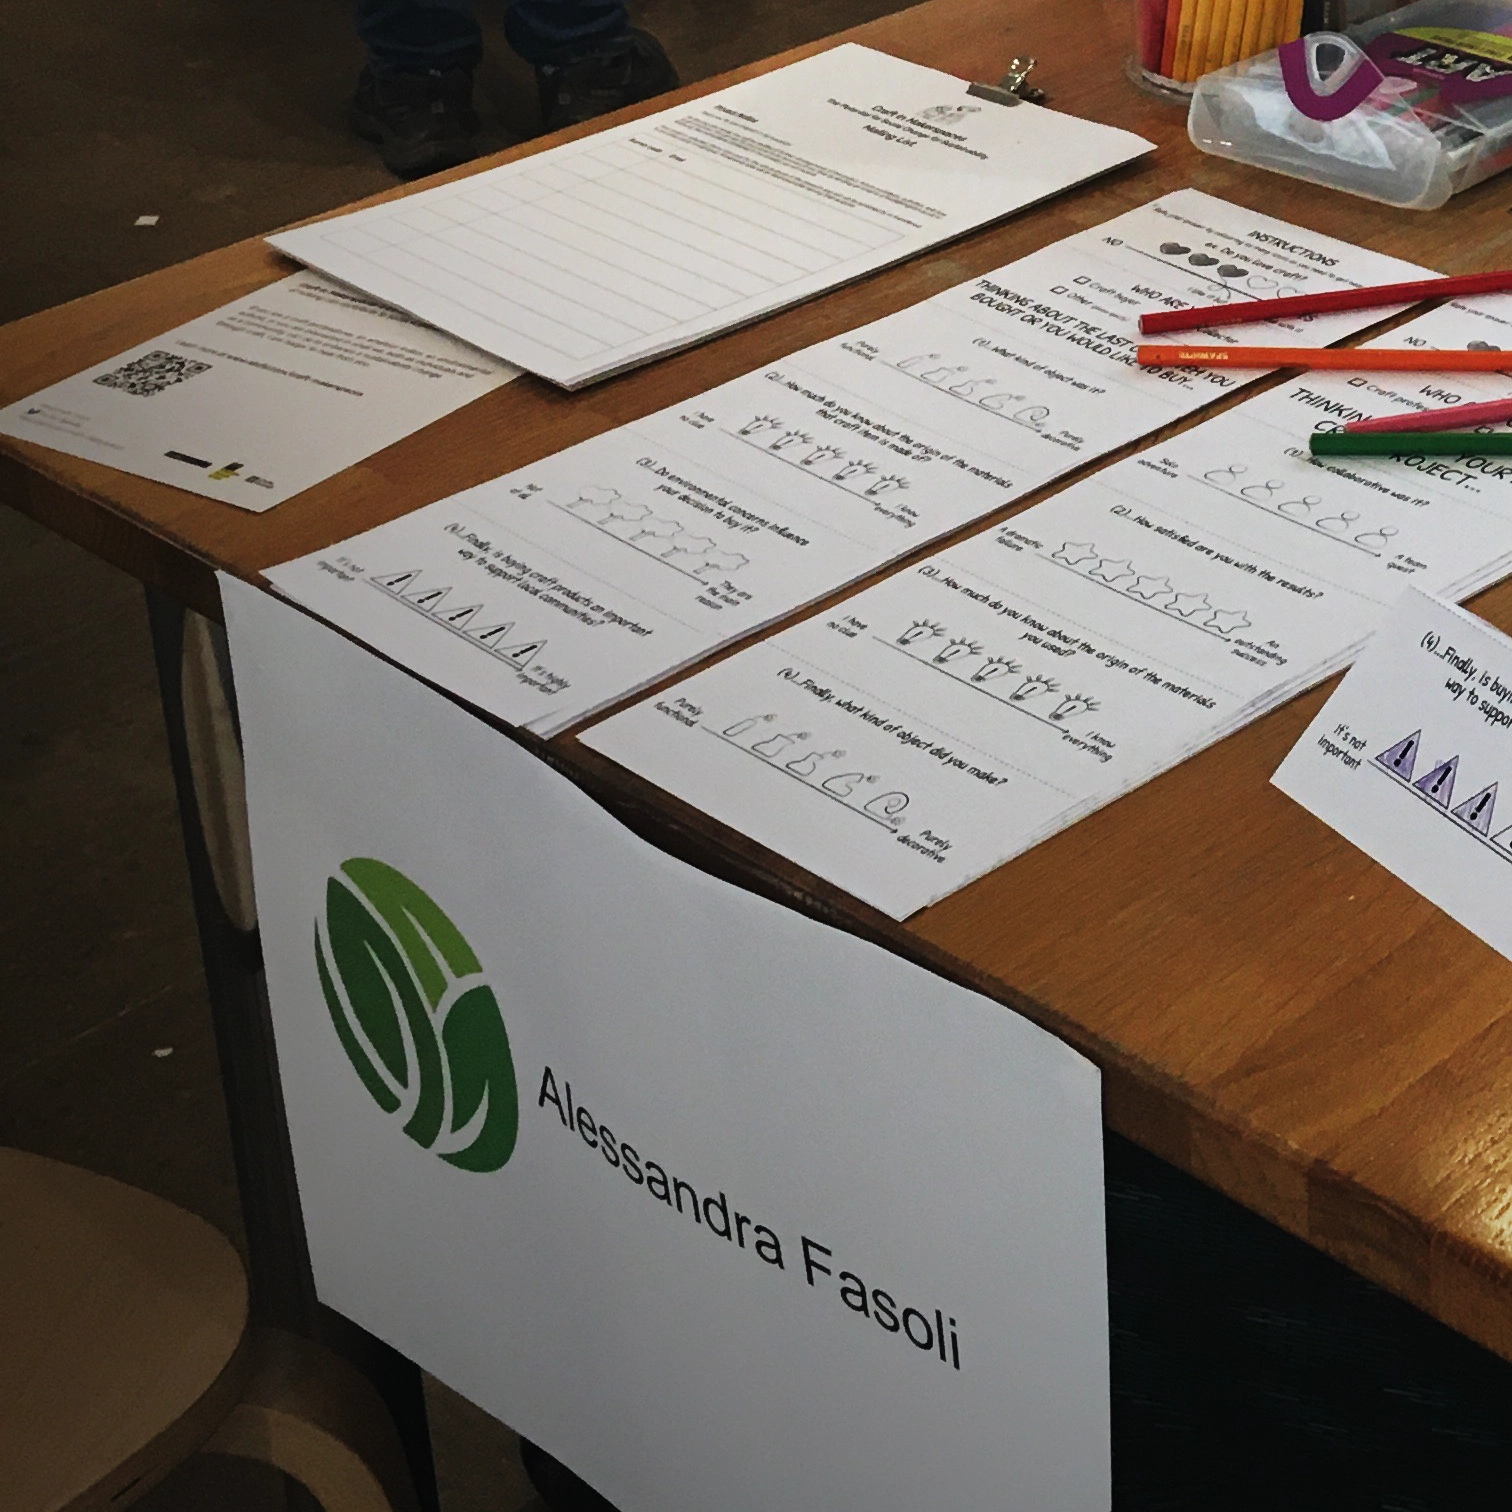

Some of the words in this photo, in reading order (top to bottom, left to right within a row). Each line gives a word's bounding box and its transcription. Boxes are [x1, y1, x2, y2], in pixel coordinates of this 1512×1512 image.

[1443, 676, 1467, 702] way
[1465, 686, 1479, 706] to
[1477, 669, 1492, 687] is
[1316, 732, 1363, 770] important
[1332, 722, 1351, 742] It's
[1347, 735, 1368, 752] not
[539, 1066, 785, 1270] Alessandra
[801, 1235, 962, 1371] Fasoli
